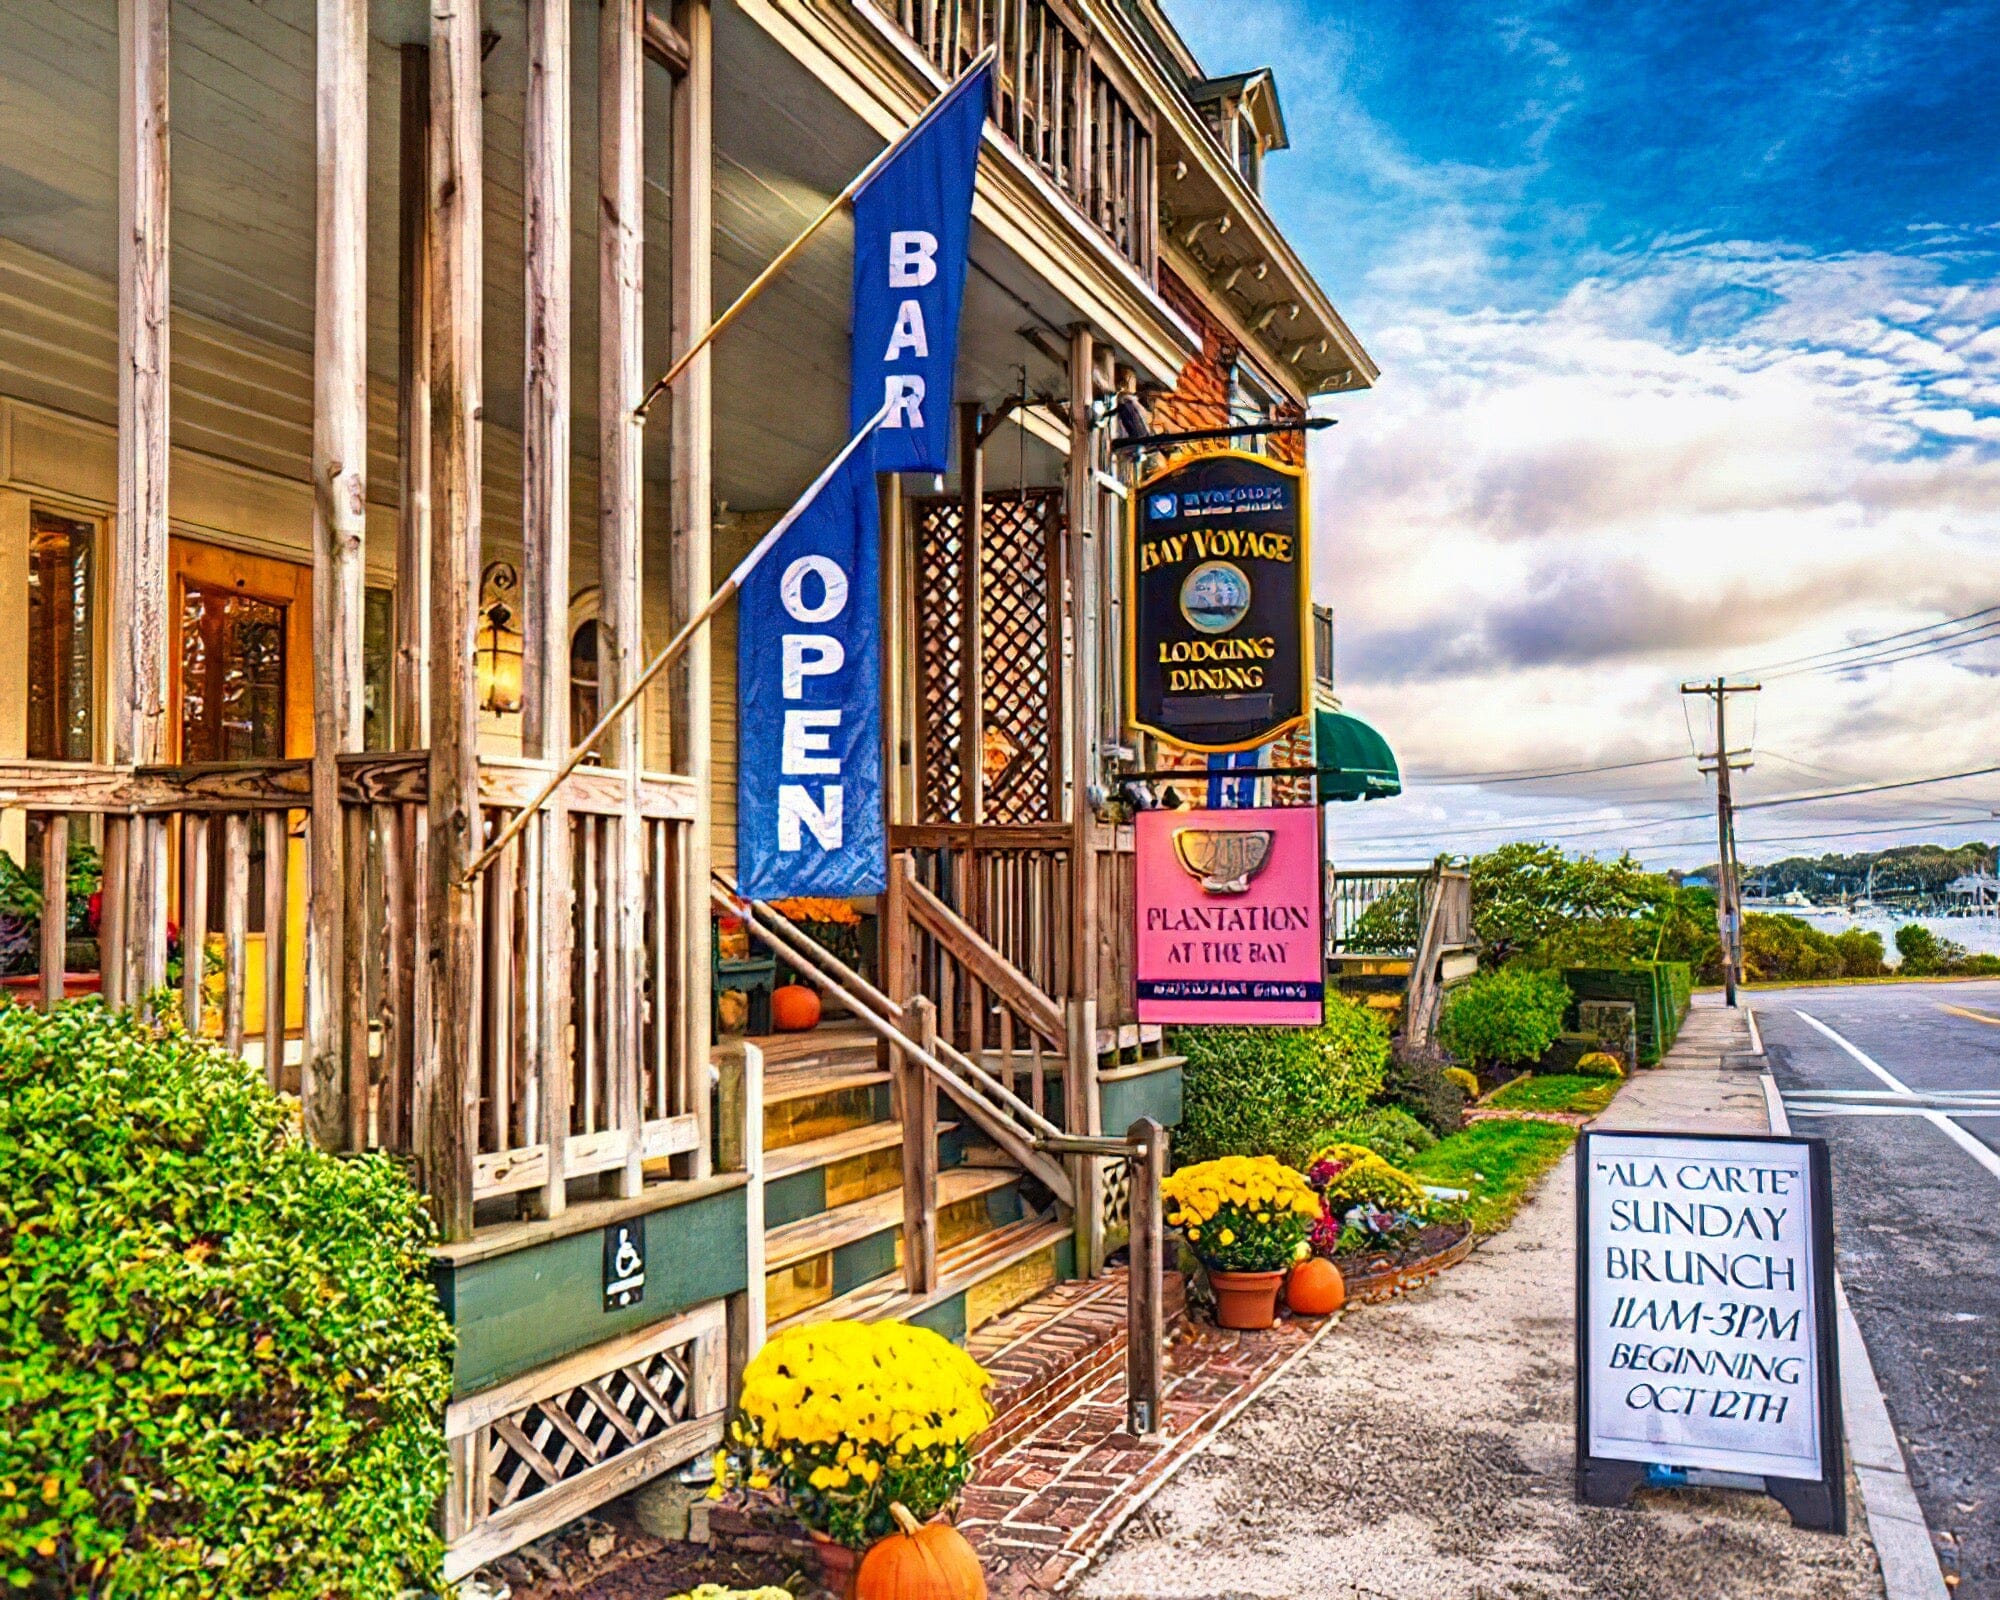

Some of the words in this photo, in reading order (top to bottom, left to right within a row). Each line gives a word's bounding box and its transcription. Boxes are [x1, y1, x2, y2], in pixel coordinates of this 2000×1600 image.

[880, 230, 939, 428] BAR
[1141, 533, 1188, 572] BAY
[1191, 529, 1295, 563] VOYAGE
[1159, 636, 1275, 663] LODGING
[1170, 666, 1264, 691] DINING
[777, 554, 849, 852] OPEN
[1147, 906, 1310, 931] PLANTATION
[1168, 942, 1196, 964] AT
[1201, 942, 1242, 964] THE
[1249, 942, 1289, 964] BAY
[1610, 1200, 1788, 1241] SUNDAY
[1606, 1247, 1795, 1291] BRUNCH
[1609, 1297, 1803, 1342] 11AM-3PM
[1609, 1343, 1806, 1385] BEGINNING
[1625, 1383, 1706, 1415] OCT
[1709, 1390, 1788, 1424] 12TH
